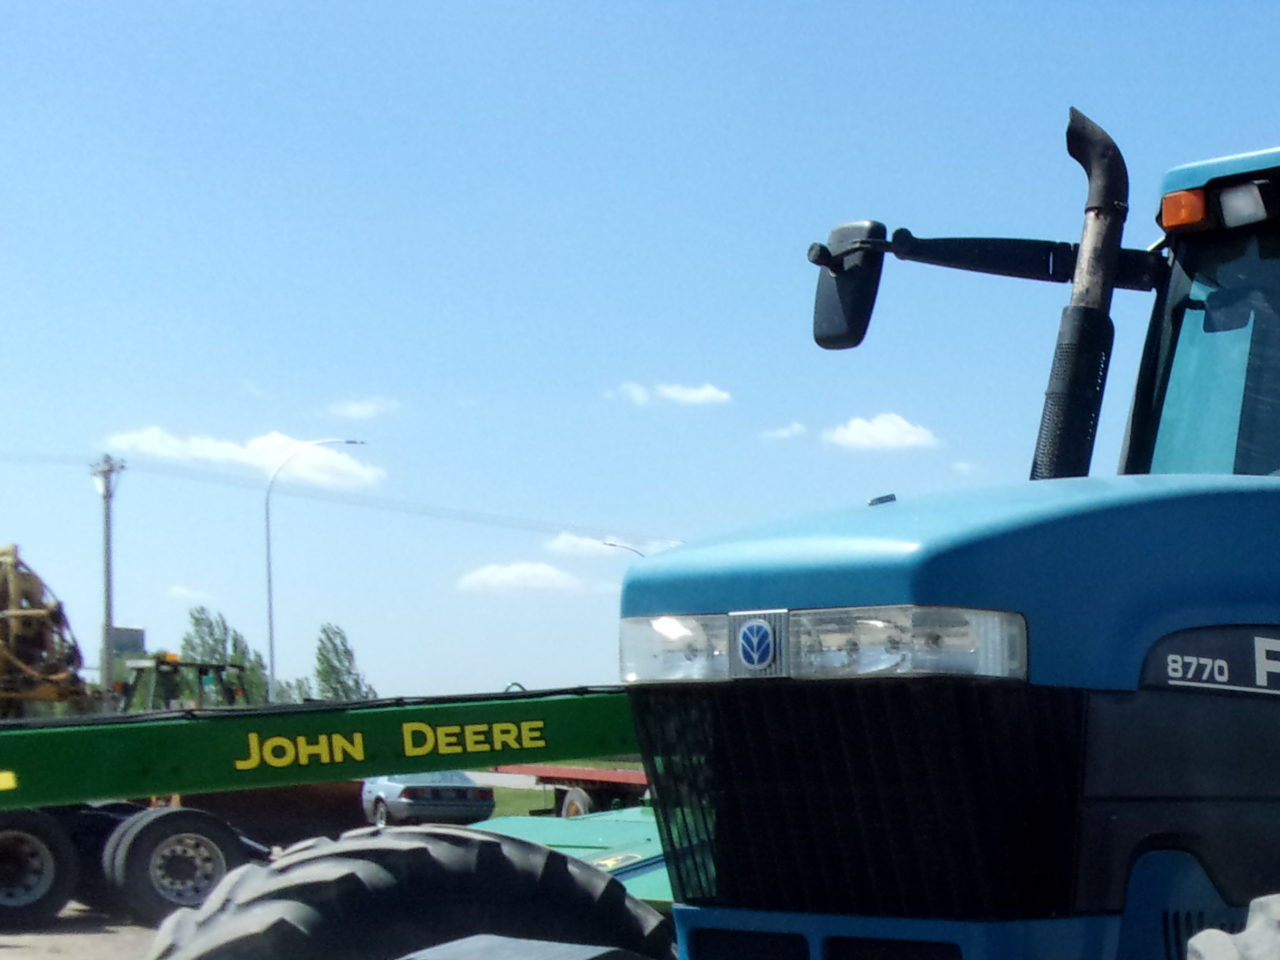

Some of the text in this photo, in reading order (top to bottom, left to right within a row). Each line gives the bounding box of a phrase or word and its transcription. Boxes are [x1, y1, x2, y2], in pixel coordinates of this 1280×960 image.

[1167, 654, 1229, 683] 8770
[234, 720, 546, 770] JOHN DEERE
